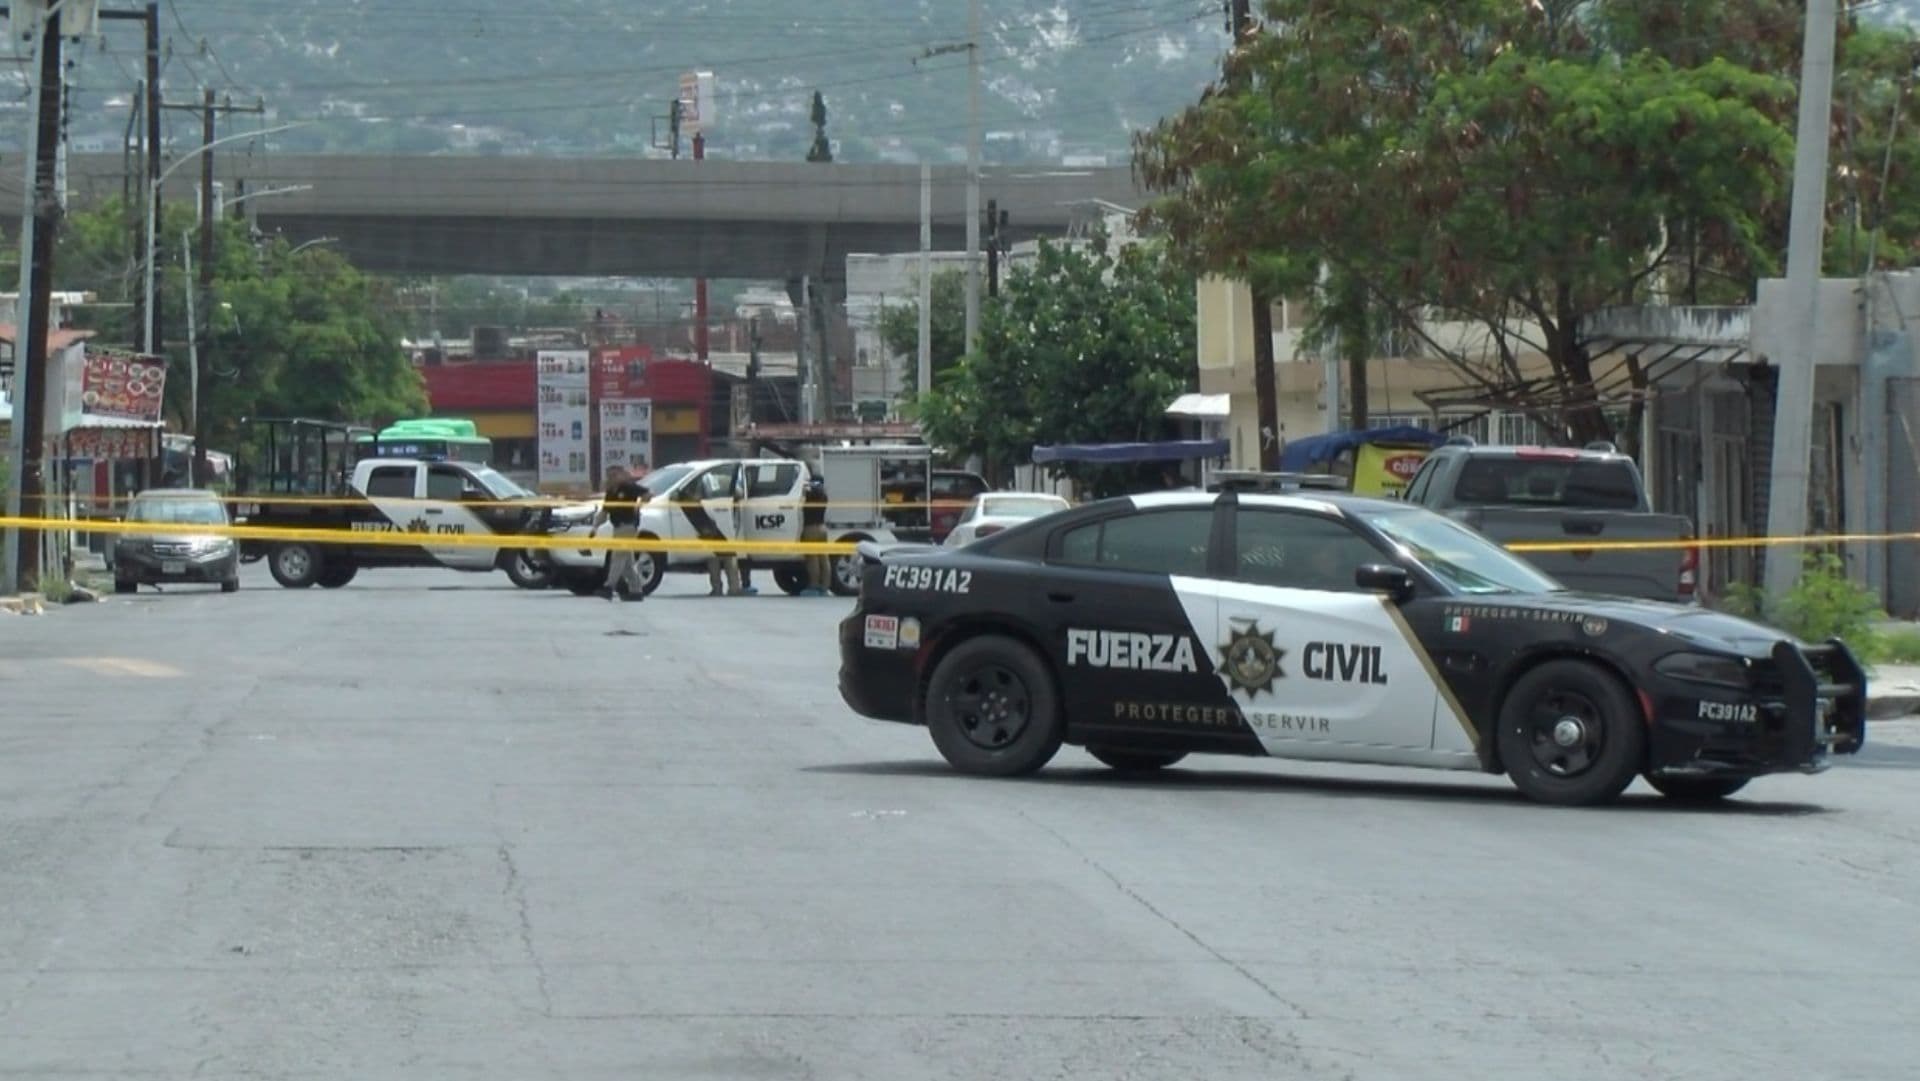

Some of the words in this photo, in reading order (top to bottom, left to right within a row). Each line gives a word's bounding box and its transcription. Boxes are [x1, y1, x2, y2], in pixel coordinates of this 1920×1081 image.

[755, 514, 785, 530] ICSP
[883, 564, 972, 594] FC391A2
[1444, 606, 1518, 619] PROTEGER
[1533, 611, 1585, 624] SERVIR
[1067, 628, 1197, 672] FUERZA
[1302, 641, 1387, 684] CIVIL
[1114, 702, 1227, 726] PROTEGER
[1234, 709, 1245, 727] Y
[1253, 711, 1331, 732] SERVIR
[1699, 700, 1757, 721] FC391A2
